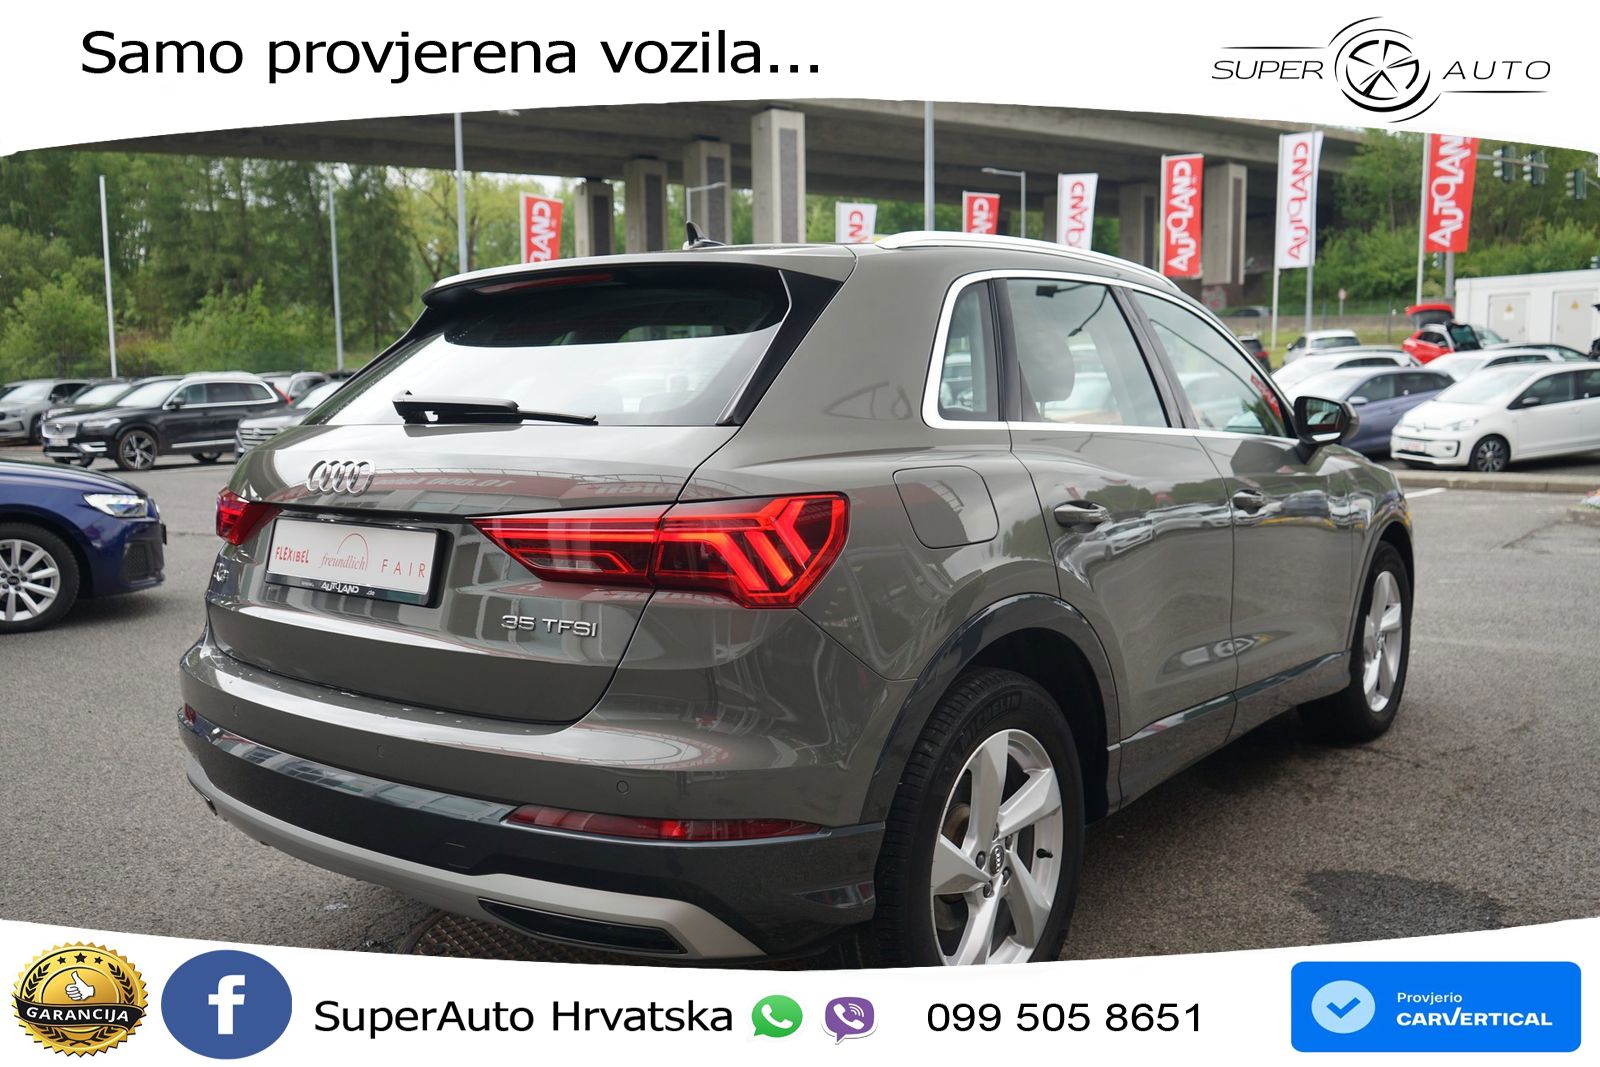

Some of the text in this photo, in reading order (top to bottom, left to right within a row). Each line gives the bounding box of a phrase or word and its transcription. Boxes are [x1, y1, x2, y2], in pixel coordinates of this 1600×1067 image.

[1287, 141, 1312, 260] AUTOLAND
[1167, 160, 1197, 273] AUTOLAND
[275, 547, 310, 563] FLEXIBEL
[318, 553, 367, 571] freundlich
[381, 559, 426, 578] FAIR
[321, 580, 360, 595] AUTOLAND
[501, 615, 598, 637] 35 TFSI
